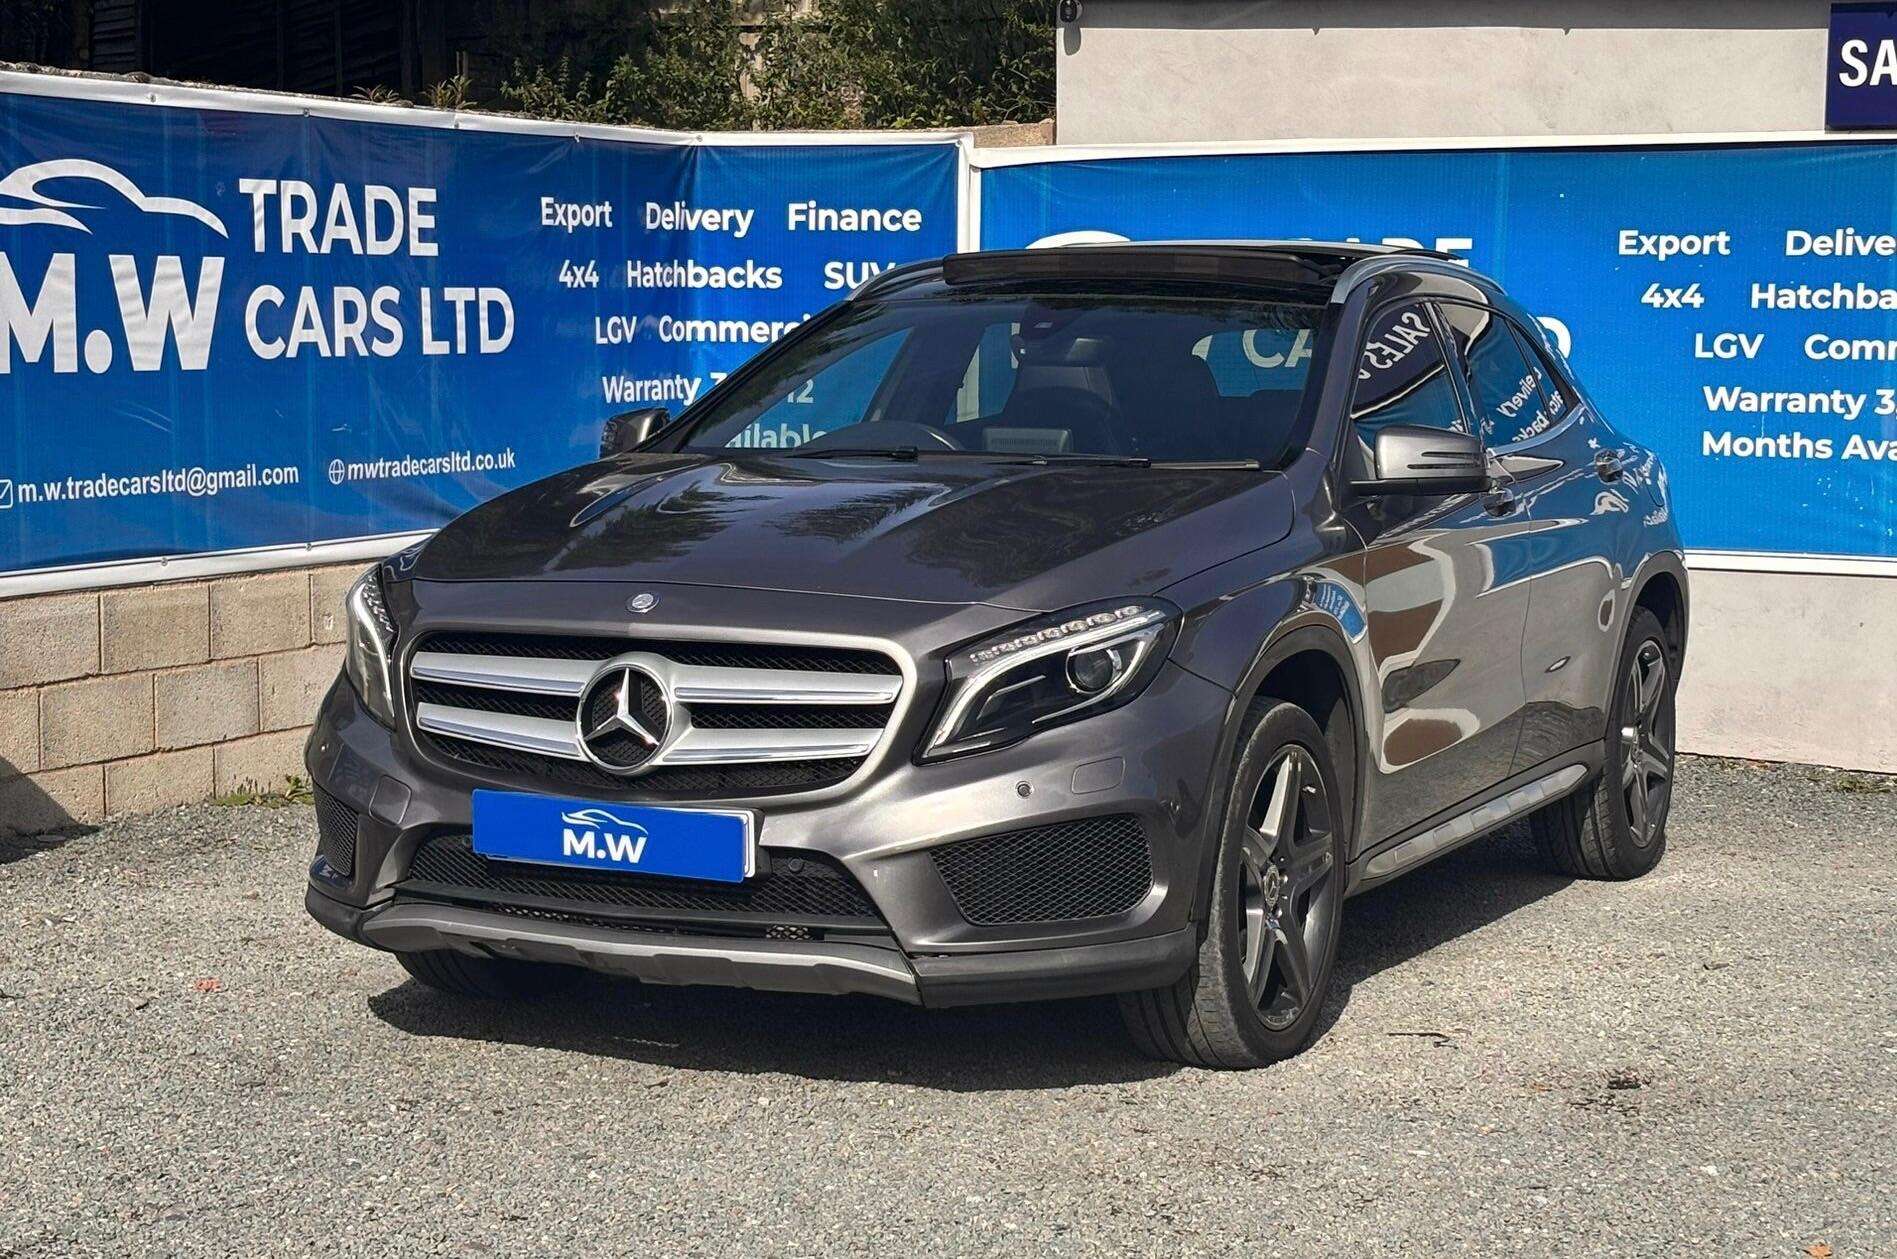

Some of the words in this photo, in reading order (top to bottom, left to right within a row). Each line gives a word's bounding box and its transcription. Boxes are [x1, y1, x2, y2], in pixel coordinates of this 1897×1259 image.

[239, 178, 438, 257] TRADE
[540, 196, 613, 233] Export
[646, 201, 754, 238] Delivery
[788, 200, 922, 231] Finance
[1618, 229, 1731, 261] Export
[1785, 227, 1896, 257] Delive
[559, 259, 599, 289] 4x4
[627, 259, 783, 290] Hatchbacks
[0, 252, 225, 374] M.W
[1640, 283, 1705, 309] 4x4
[1751, 282, 1897, 310] Hatchba
[245, 284, 404, 360] CARS
[421, 287, 514, 355] LTD
[595, 315, 637, 345] LGV
[1694, 333, 1764, 359] LGV
[602, 373, 701, 406] Warranty
[1703, 385, 1866, 420] Warranty
[1702, 431, 1833, 460] Months
[18, 464, 299, 502] m.w.tradecarsltd@gmail.com
[348, 447, 515, 480] mwtradecarsltd.co.uk
[563, 828, 647, 864] M.W
